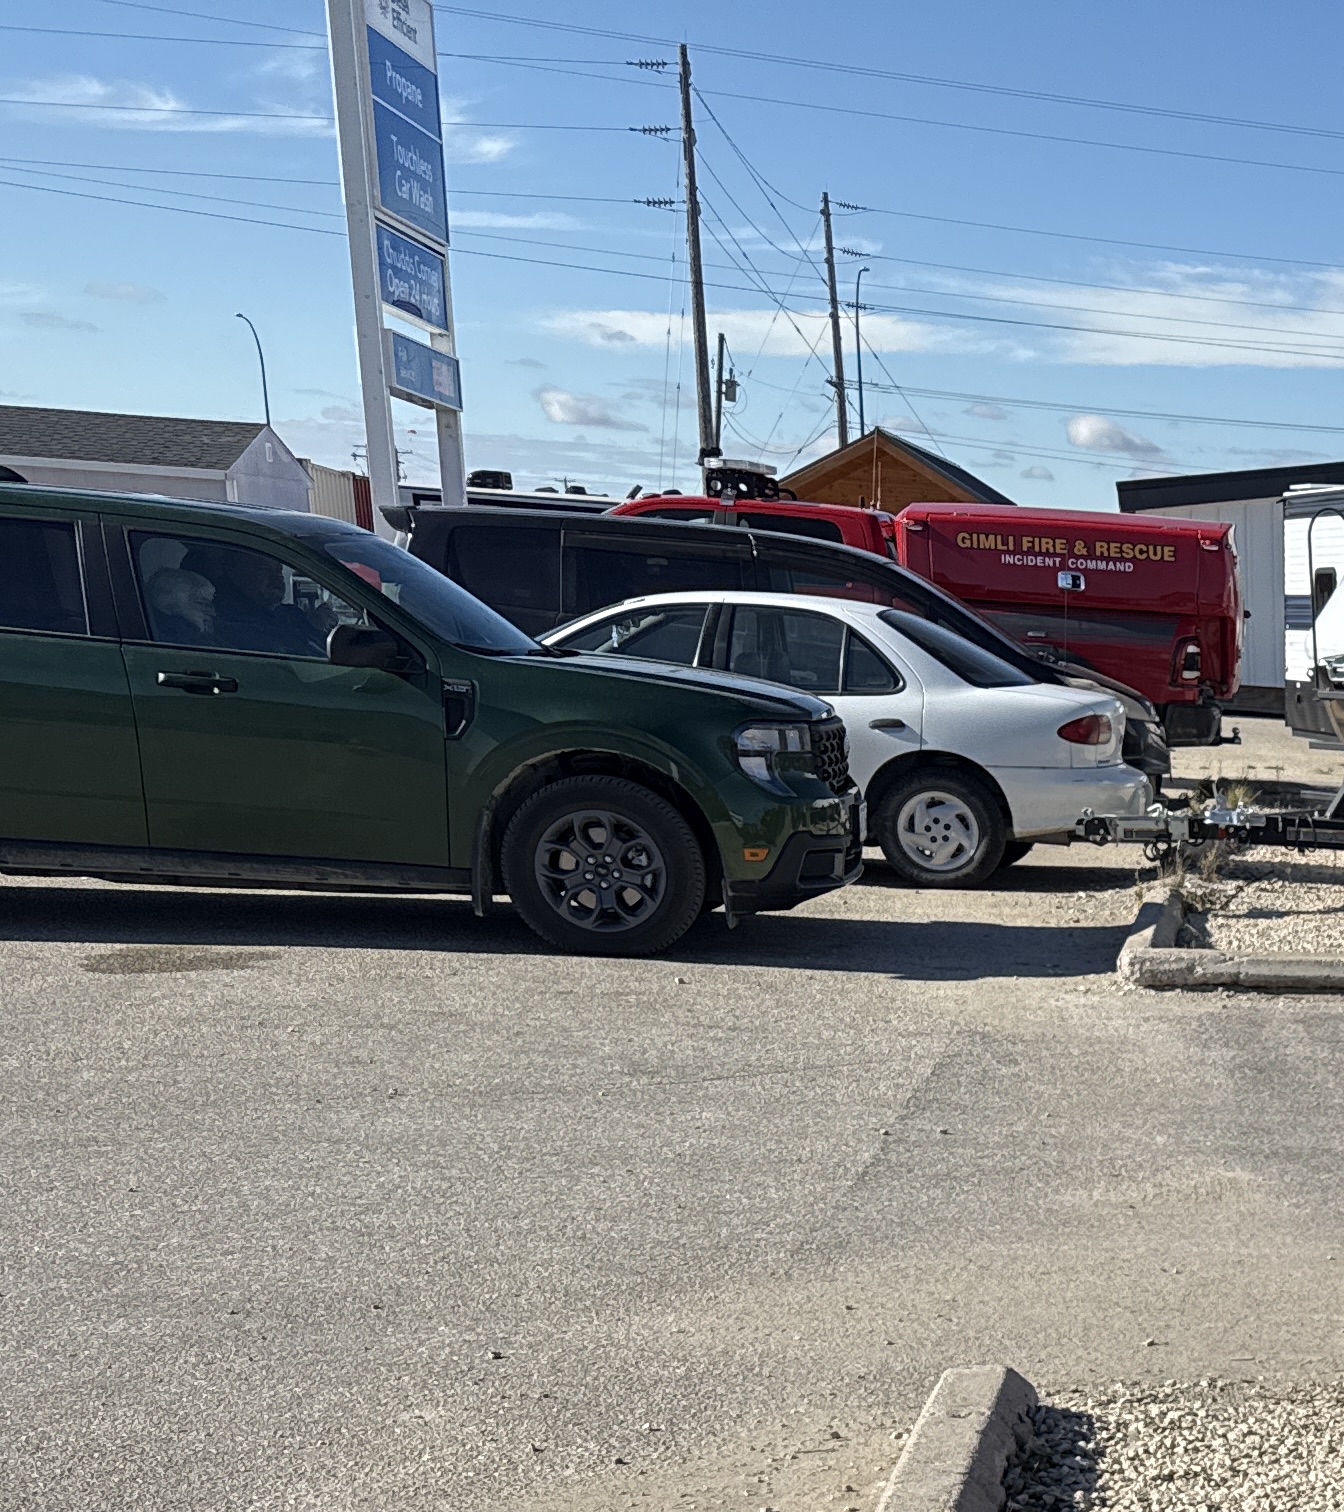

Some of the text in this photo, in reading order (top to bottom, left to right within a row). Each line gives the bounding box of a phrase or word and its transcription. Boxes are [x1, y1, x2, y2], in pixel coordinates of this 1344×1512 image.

[385, 60, 423, 108] Propane
[391, 134, 433, 182] Touchless
[396, 170, 434, 214] Car Wash
[387, 268, 409, 301] Open
[956, 532, 1176, 562] GIMLI FIRE & RESCUE
[1001, 553, 1134, 572] INCIDENT COMMAND
